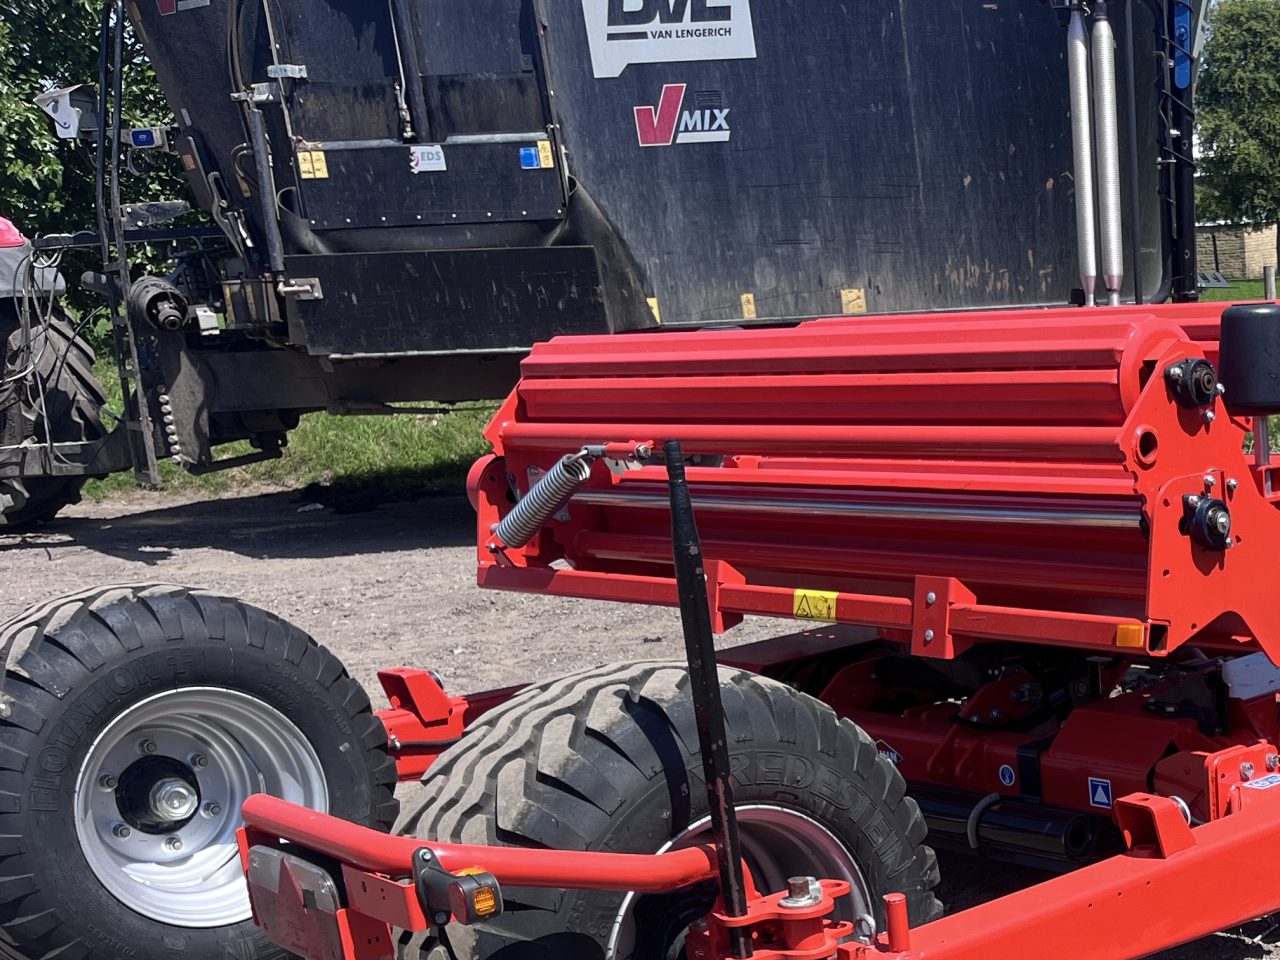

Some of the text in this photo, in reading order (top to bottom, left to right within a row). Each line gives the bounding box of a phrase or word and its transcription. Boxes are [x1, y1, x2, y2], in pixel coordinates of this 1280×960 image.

[650, 28, 732, 40] VAN LENGERICH
[420, 151, 442, 162] EDS
[27, 660, 162, 812] FLOTATION
